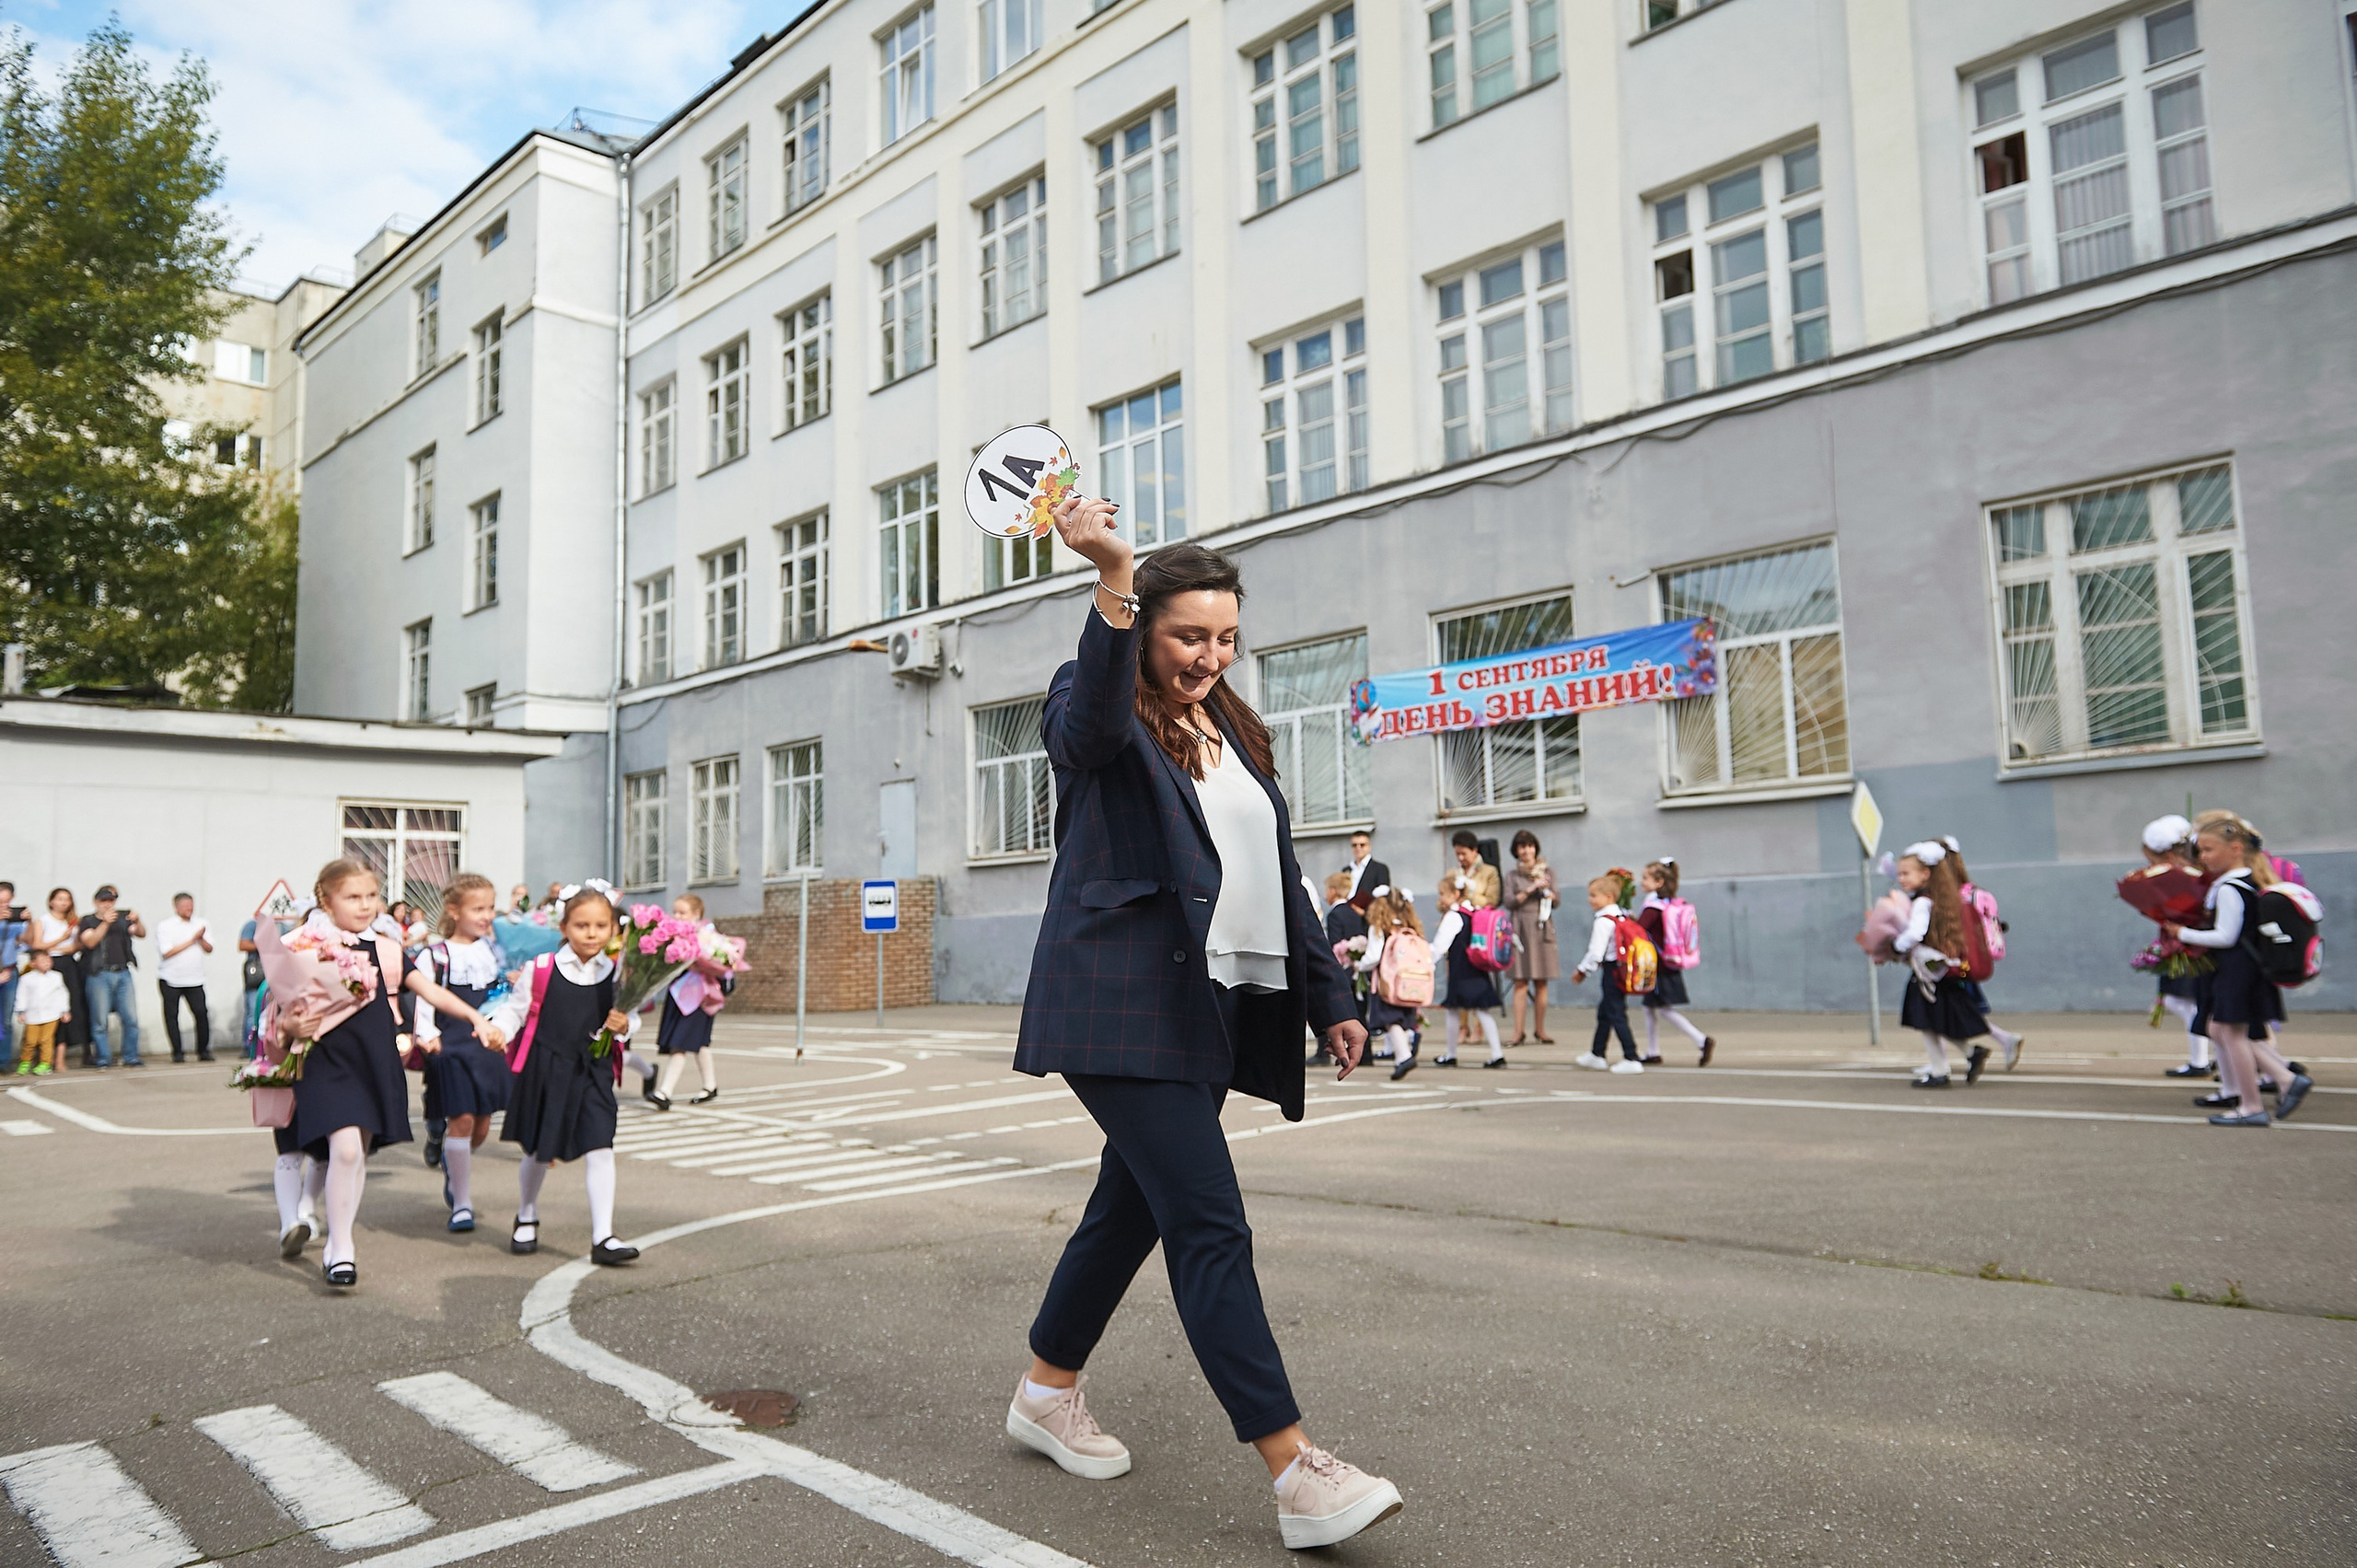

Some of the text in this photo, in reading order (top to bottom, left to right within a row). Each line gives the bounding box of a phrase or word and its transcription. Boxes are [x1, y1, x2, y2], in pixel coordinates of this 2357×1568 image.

[1381, 659, 1674, 738] ДЕНЬ ЗНАНИЙ!
[1429, 646, 1608, 696] 1 СЕНТЯБРЯ
